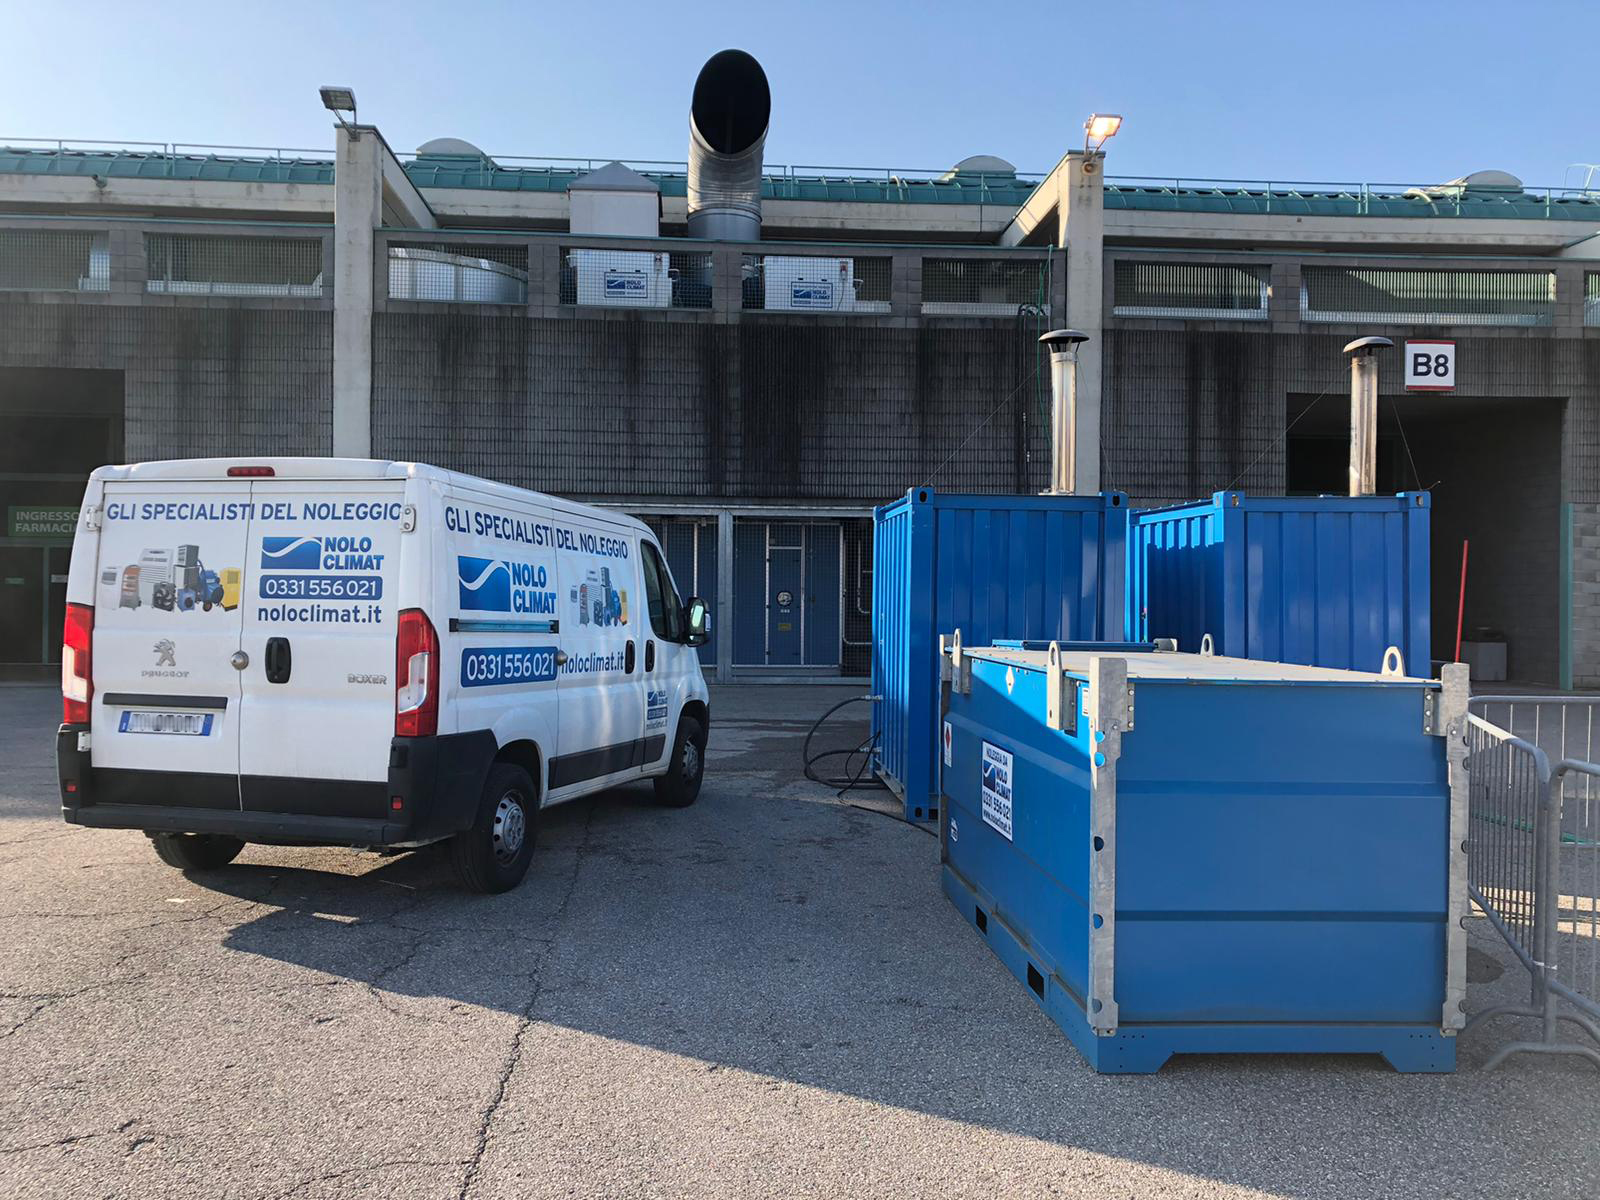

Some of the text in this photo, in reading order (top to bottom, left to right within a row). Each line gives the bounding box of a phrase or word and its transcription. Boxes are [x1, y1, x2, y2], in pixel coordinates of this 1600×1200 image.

[1413, 353, 1449, 377] B8
[107, 503, 402, 520] GLI SPECIALISTI DEL NOLEGGIO
[15, 523, 76, 533] FARMACI
[445, 506, 628, 559] GLI SPECIALISTI DEL NOLEGGIO
[324, 536, 372, 552] NOLO
[323, 554, 384, 570] CLIMAT
[512, 562, 547, 588] NOLO
[513, 589, 556, 614] CLIMAT
[258, 603, 382, 623] noloclimat.it
[141, 670, 190, 678] PEUGEOT
[347, 673, 387, 685] BOXER
[996, 766, 1008, 784] NOLO
[996, 781, 1010, 801] CLIMAT
